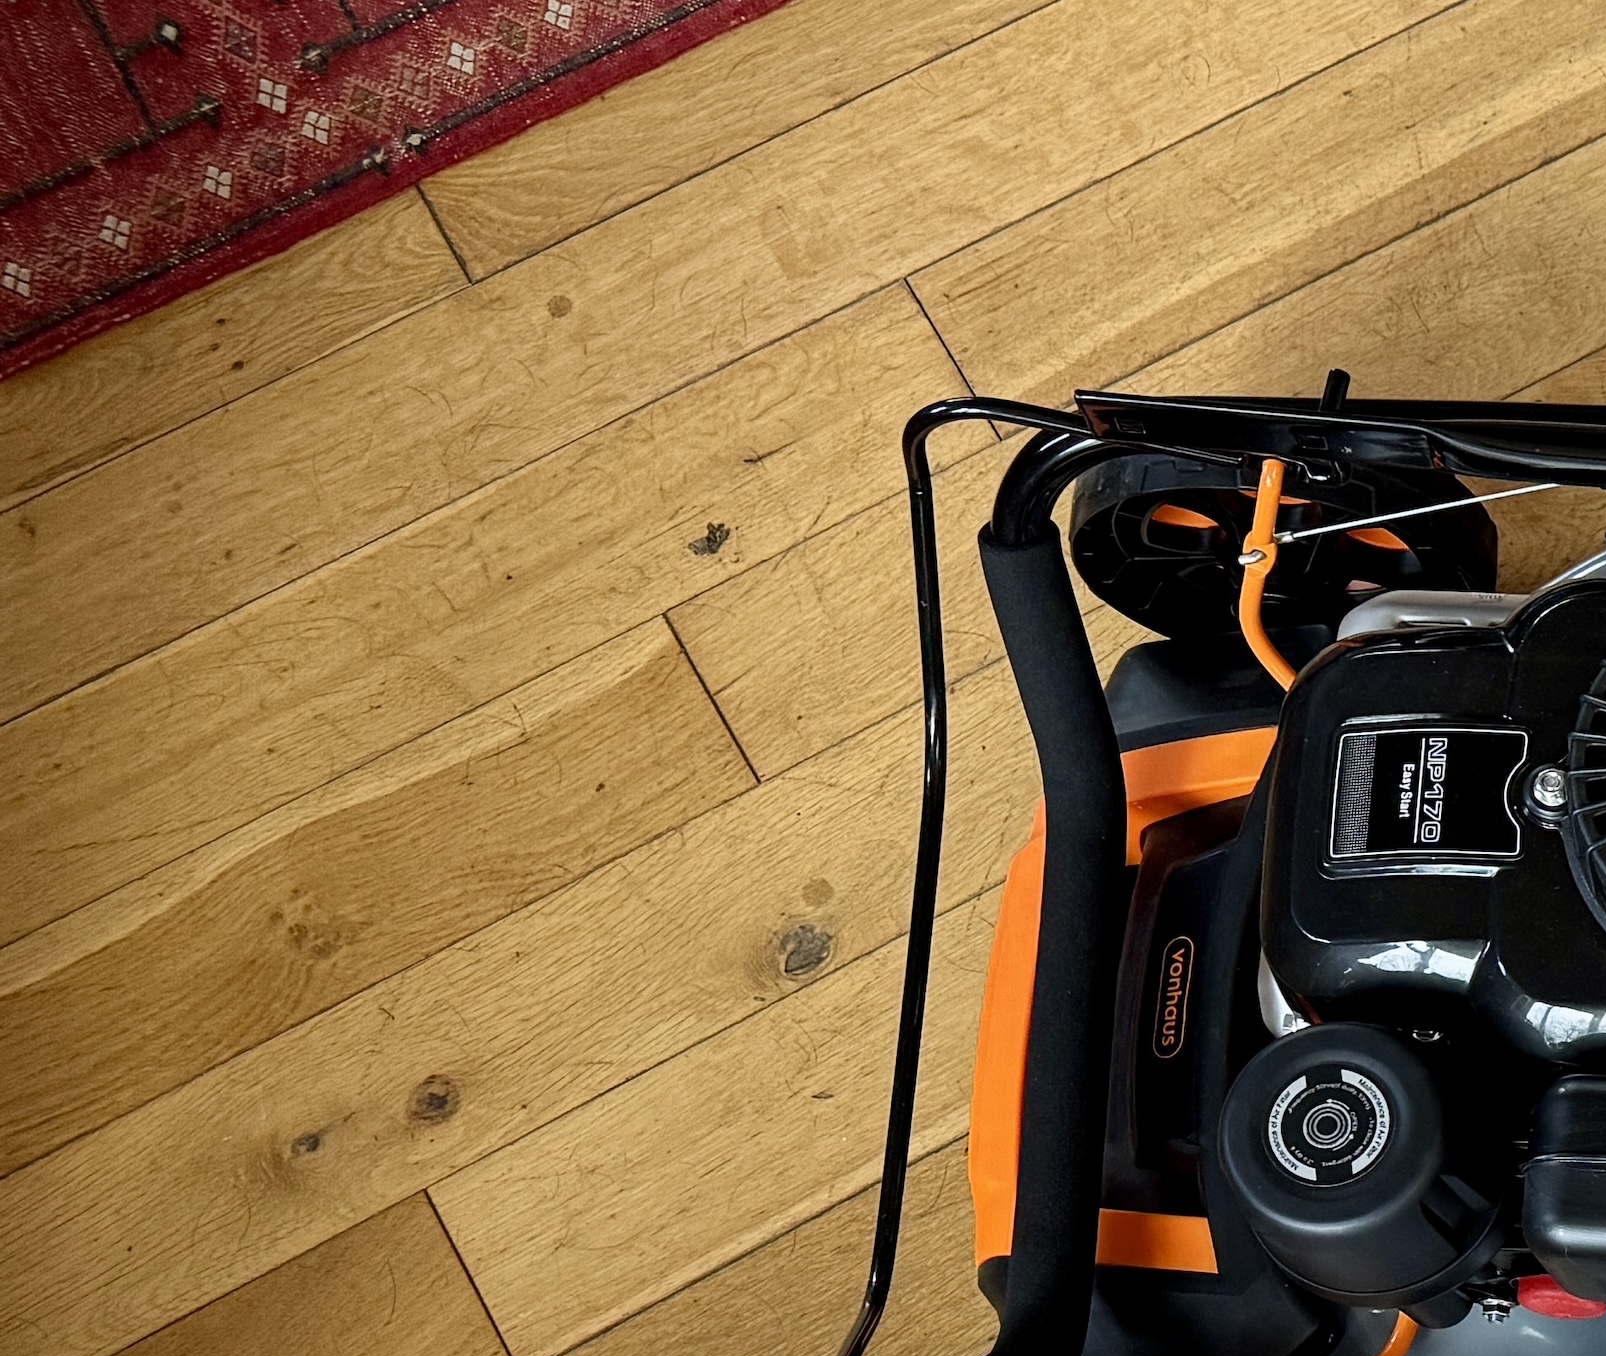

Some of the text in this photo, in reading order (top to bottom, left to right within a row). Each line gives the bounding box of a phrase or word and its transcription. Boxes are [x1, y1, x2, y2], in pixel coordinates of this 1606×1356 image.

[1399, 763, 1415, 819] Easy Start
[1420, 737, 1448, 843] NP170
[1161, 947, 1185, 1046] vonhaus
